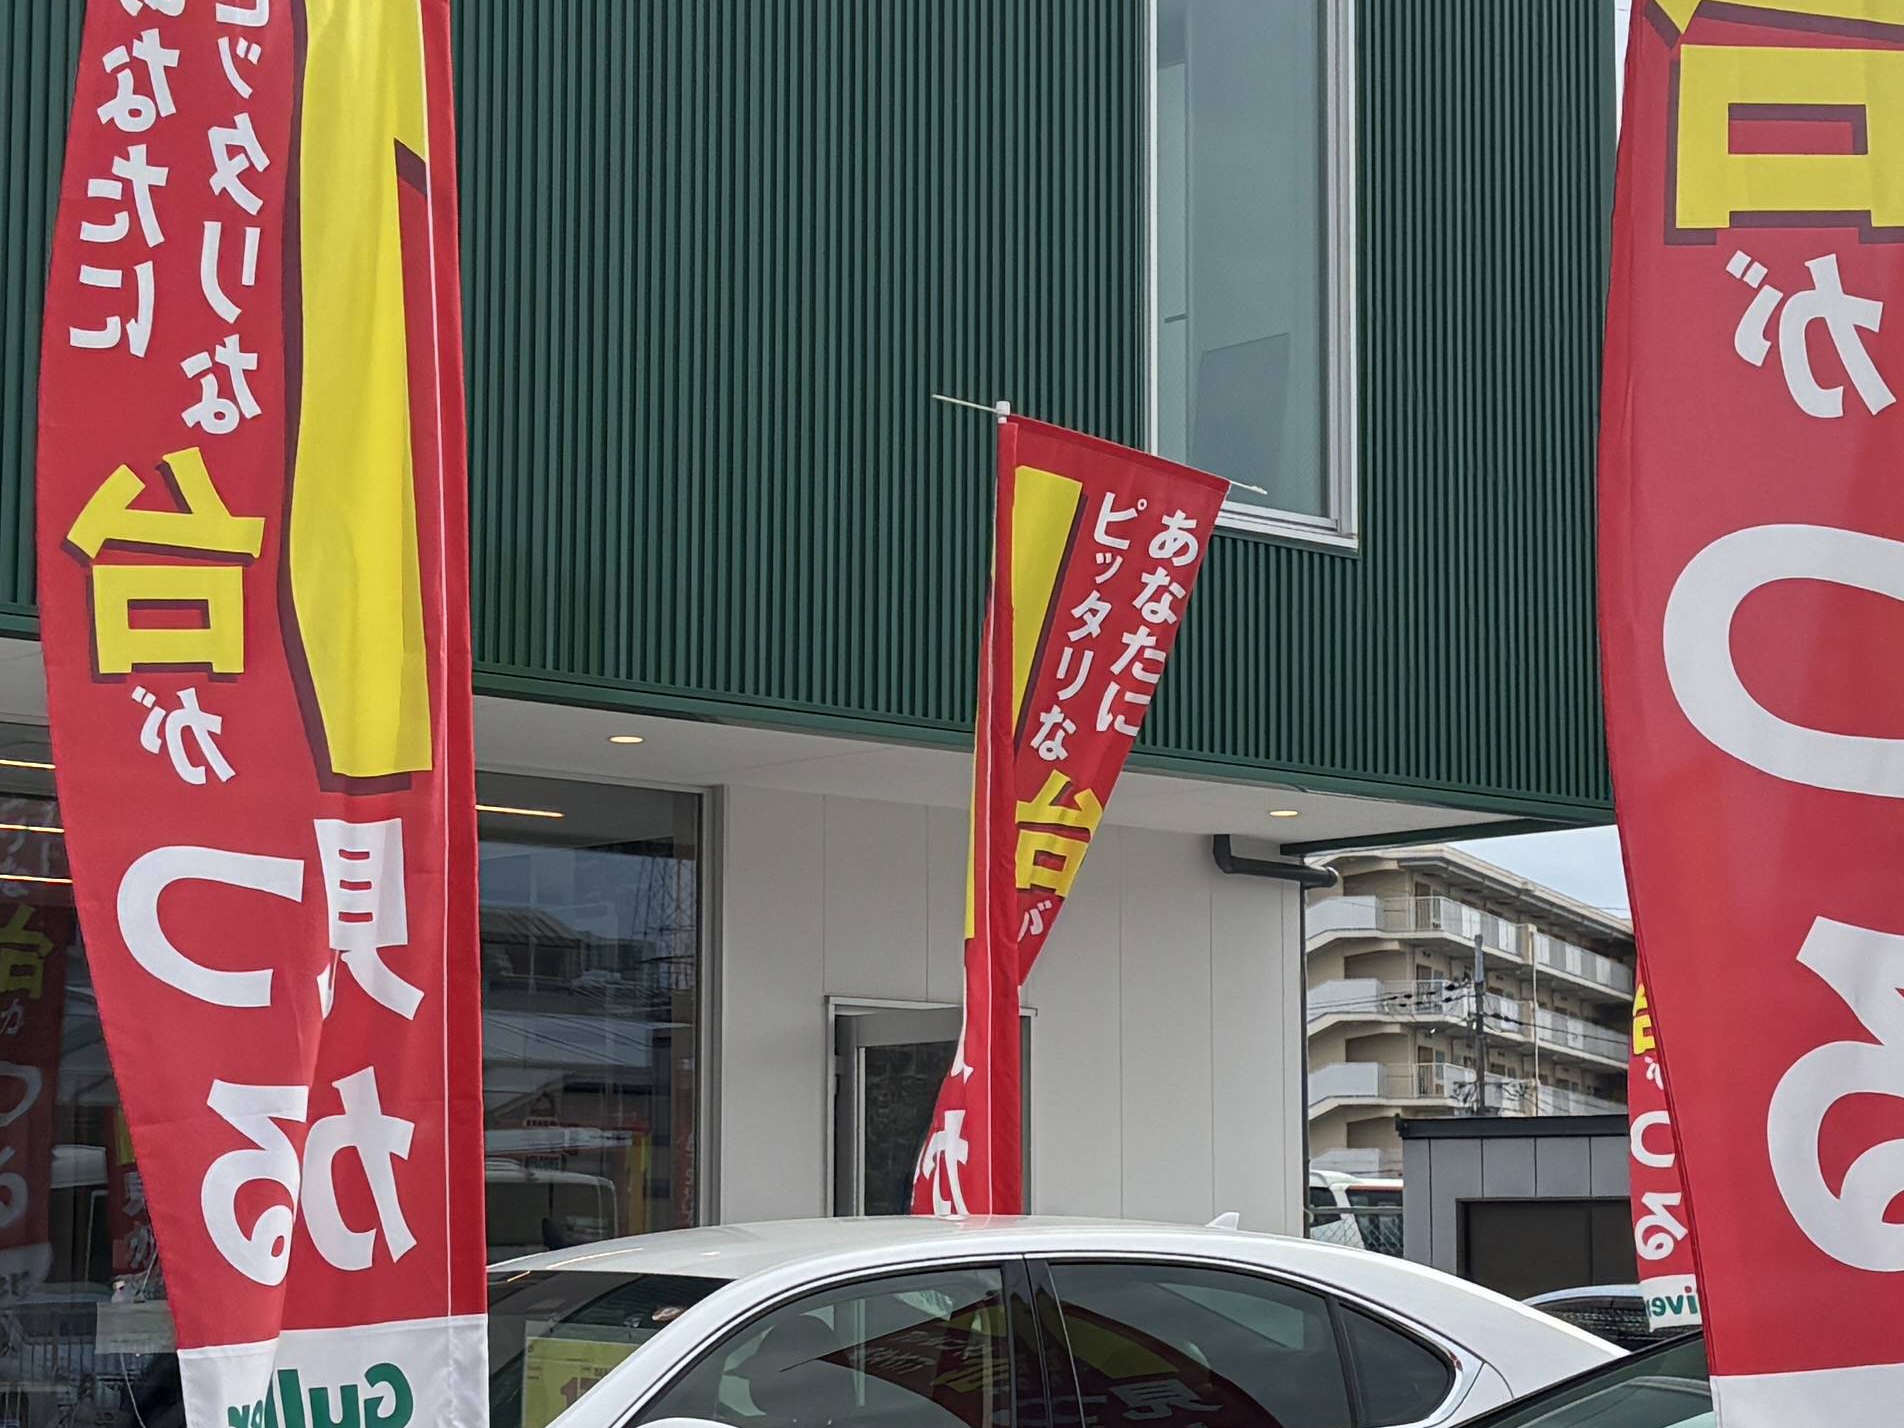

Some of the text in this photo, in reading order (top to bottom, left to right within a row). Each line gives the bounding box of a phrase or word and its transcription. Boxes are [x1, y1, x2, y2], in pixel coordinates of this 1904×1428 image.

[1029, 491, 1147, 762] ピッタリな
[1095, 509, 1199, 737] あなたに
